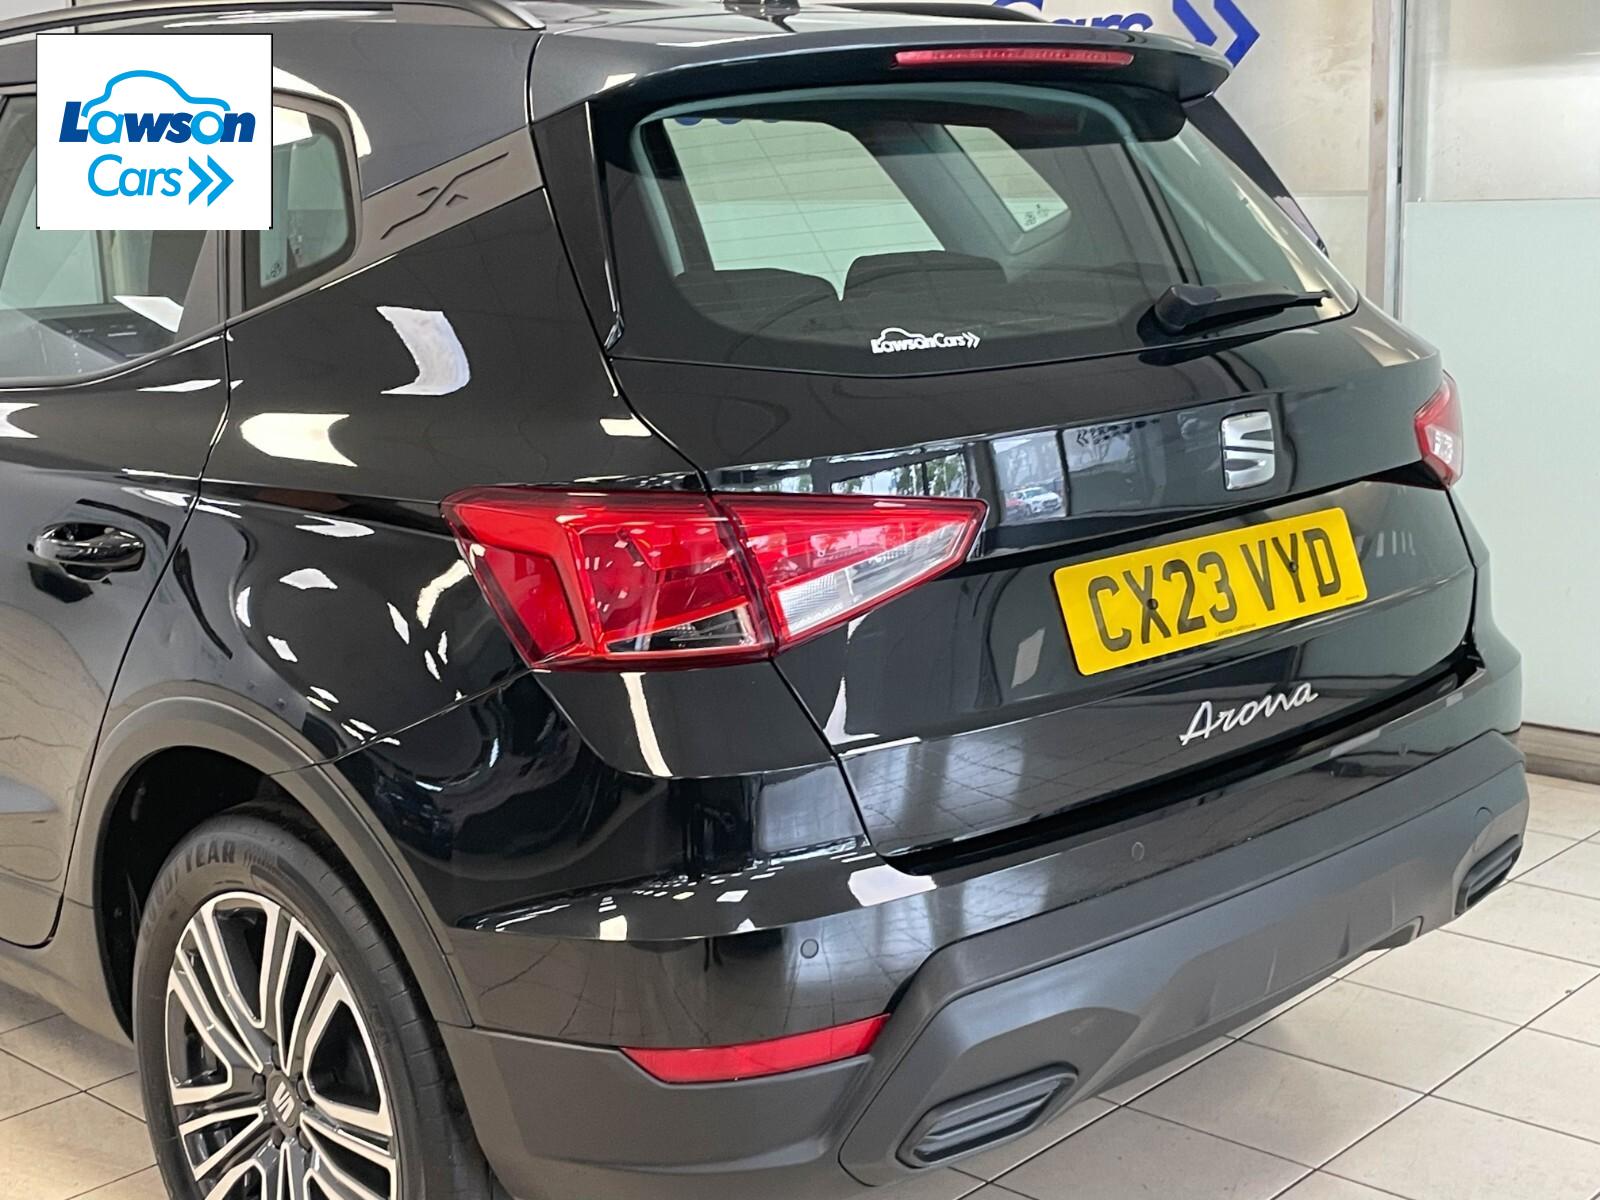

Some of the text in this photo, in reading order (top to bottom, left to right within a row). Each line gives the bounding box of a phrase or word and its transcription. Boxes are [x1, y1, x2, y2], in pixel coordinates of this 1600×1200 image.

[1087, 527, 1341, 652] CX23 VYD
[1179, 682, 1319, 746] Arona
